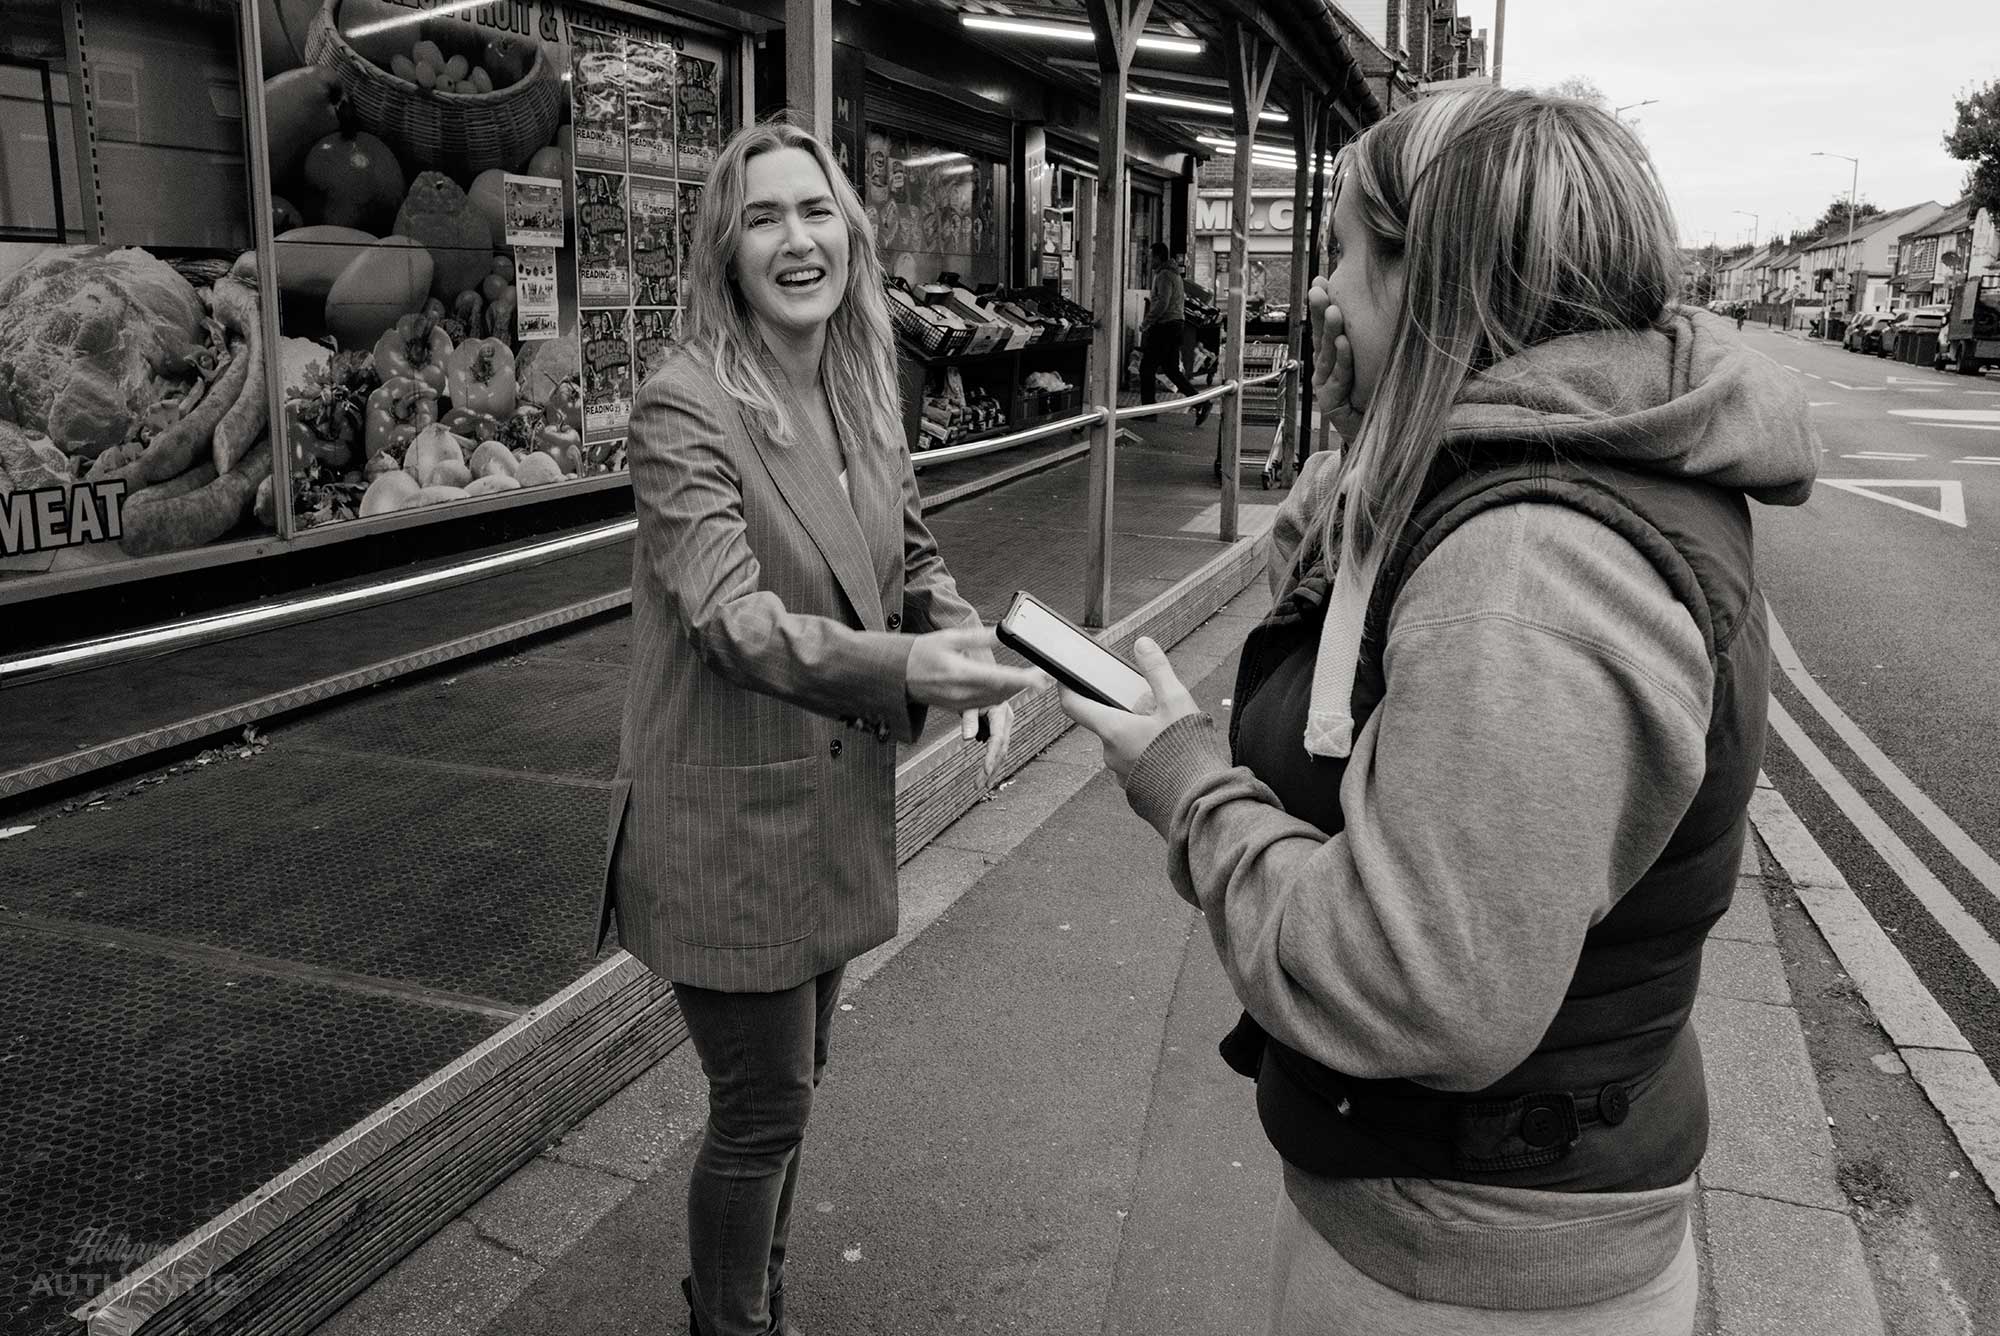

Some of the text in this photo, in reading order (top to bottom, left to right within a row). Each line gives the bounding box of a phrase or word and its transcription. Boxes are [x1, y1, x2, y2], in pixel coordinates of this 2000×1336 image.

[581, 204, 622, 223] CIRCUS
[581, 270, 610, 279] READING
[586, 341, 626, 361] CIRCUS
[585, 404, 614, 415] READING
[0, 478, 127, 558] MEAT
